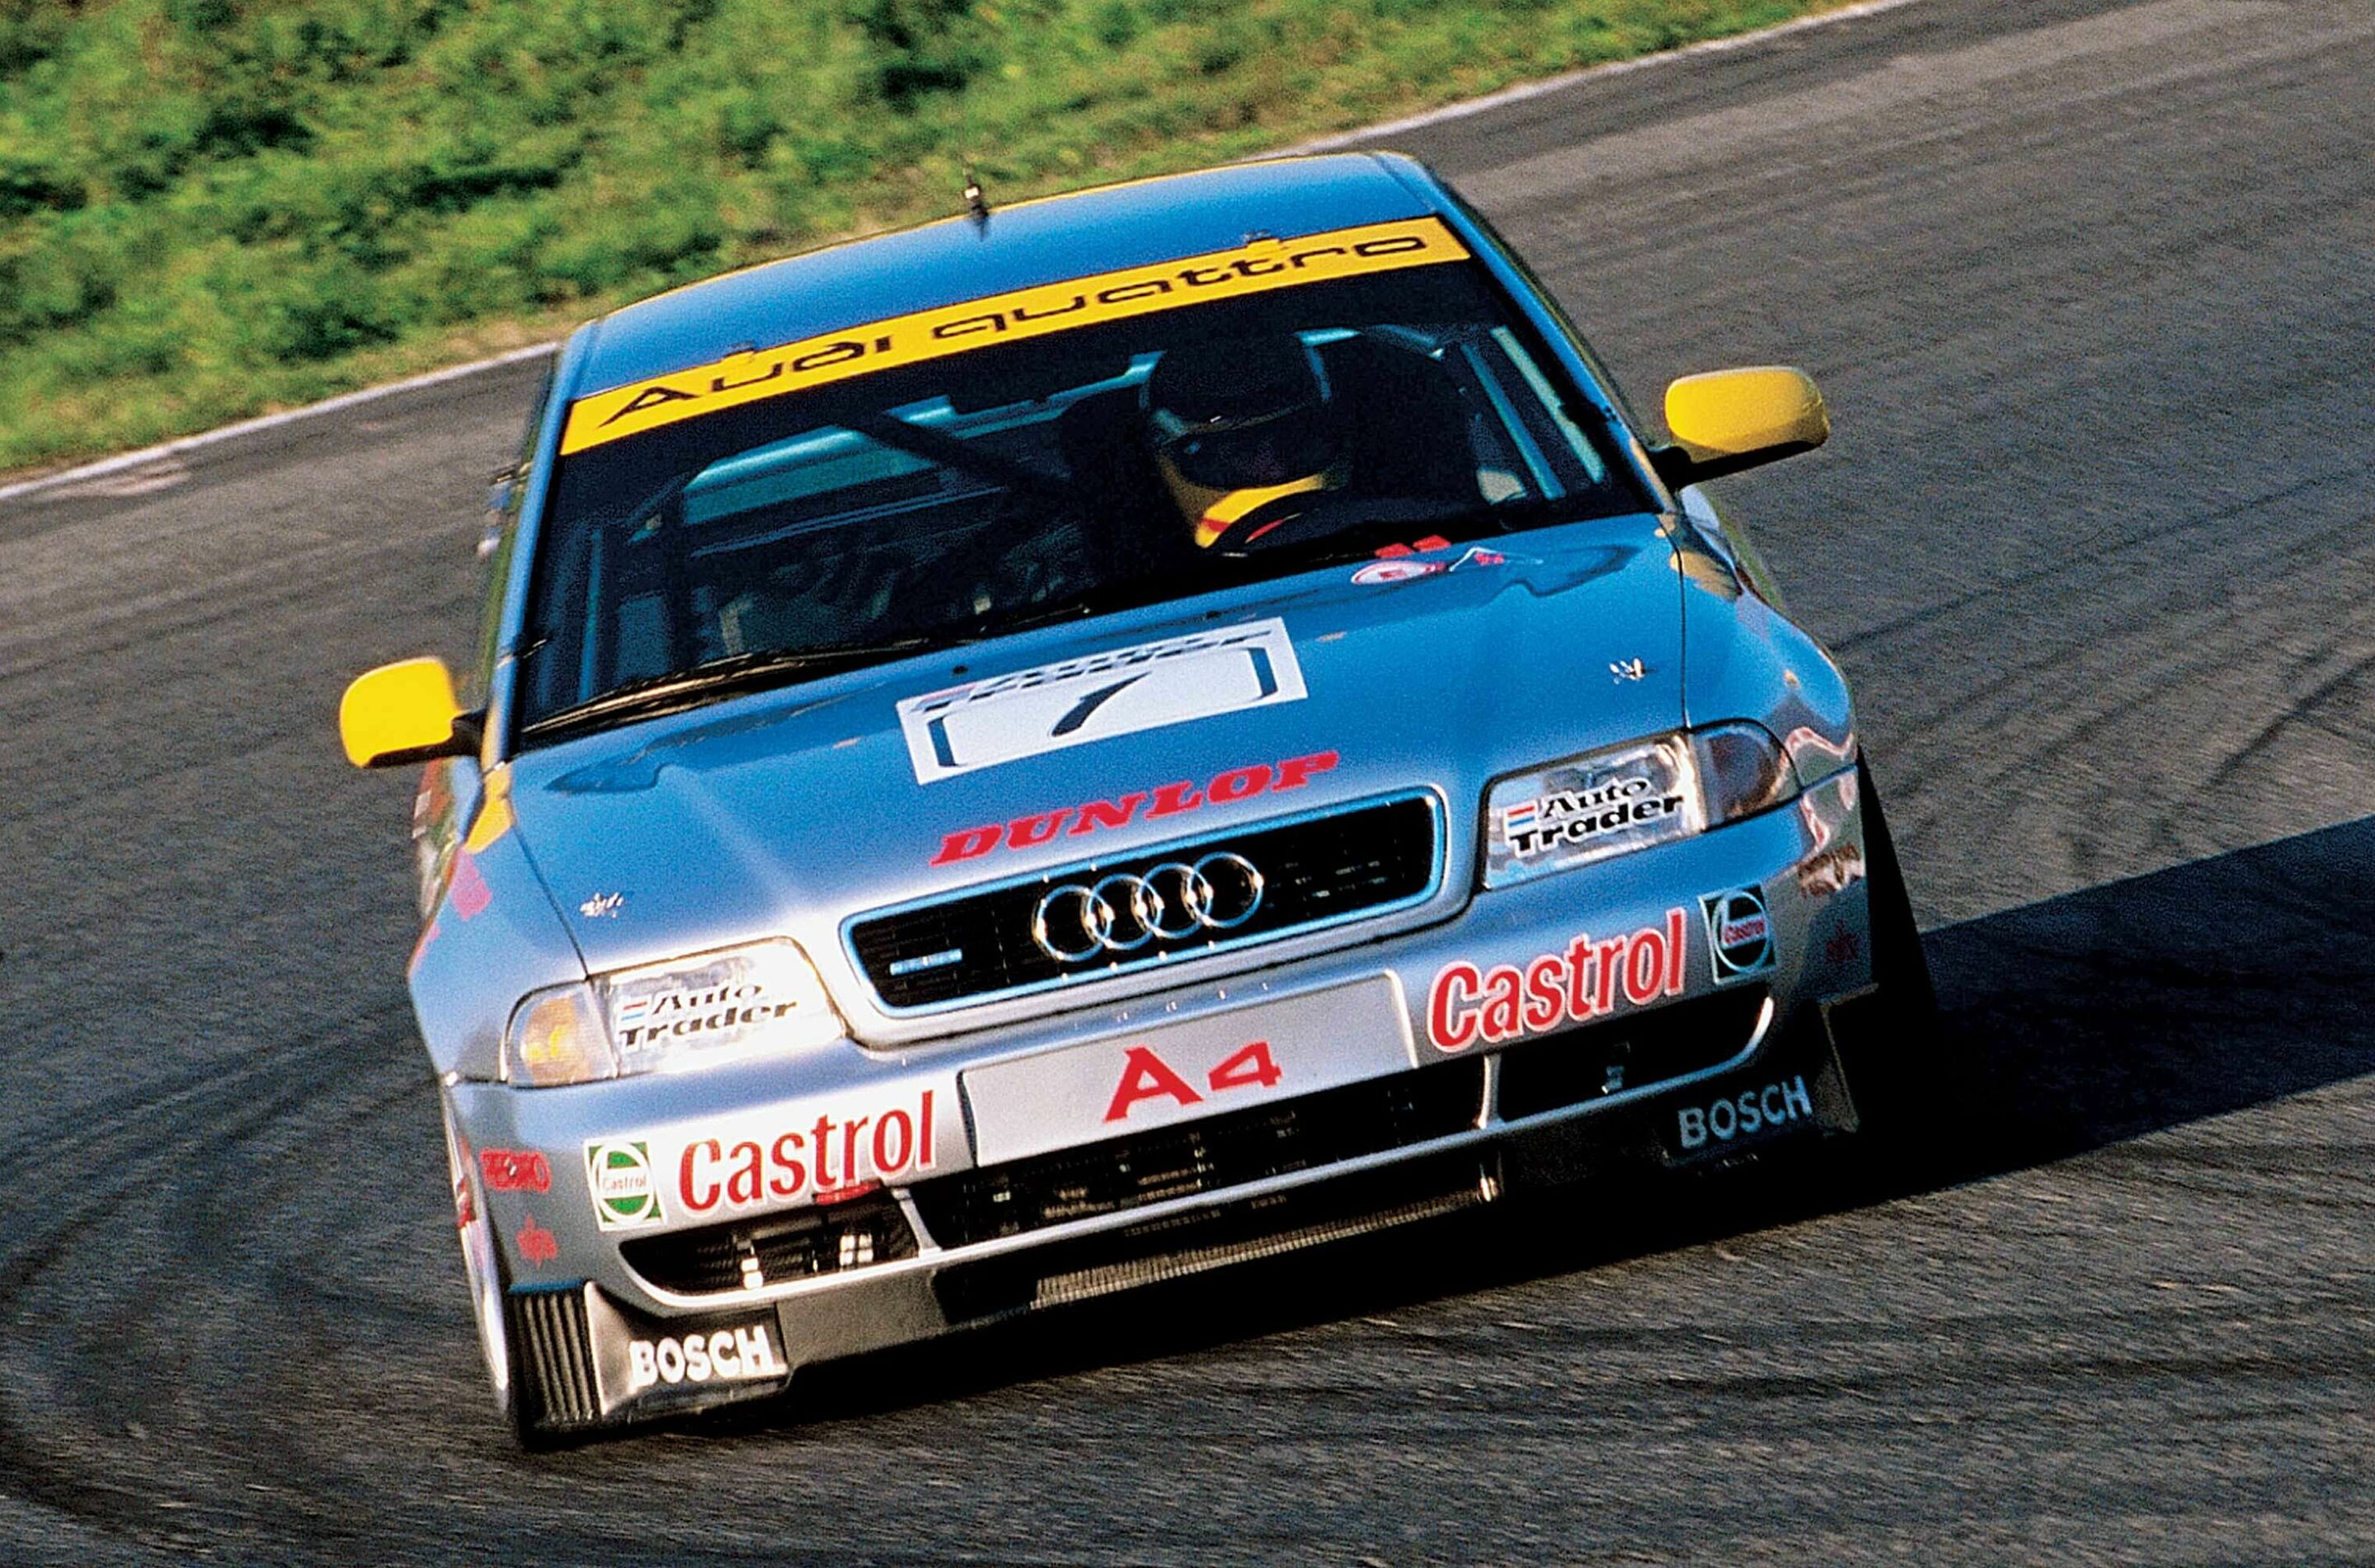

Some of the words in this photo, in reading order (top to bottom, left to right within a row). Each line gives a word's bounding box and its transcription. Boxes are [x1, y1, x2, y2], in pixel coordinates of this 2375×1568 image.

[598, 335, 893, 428] Audi
[932, 236, 1427, 340] quattro
[1050, 671, 1152, 737] 7
[929, 750, 1340, 866] DUNLOP
[1509, 796, 1684, 852] Trader
[1544, 780, 1648, 818] Auto
[652, 986, 762, 1015] Auto
[1427, 907, 1686, 1054] Castrol
[619, 1002, 797, 1046] Trader
[1103, 1041, 1282, 1124] A4
[1678, 1075, 1813, 1148] BOSCH
[602, 1174, 648, 1190] Castrol
[678, 1089, 934, 1212] Castrol
[629, 1325, 775, 1388] BOSCH
